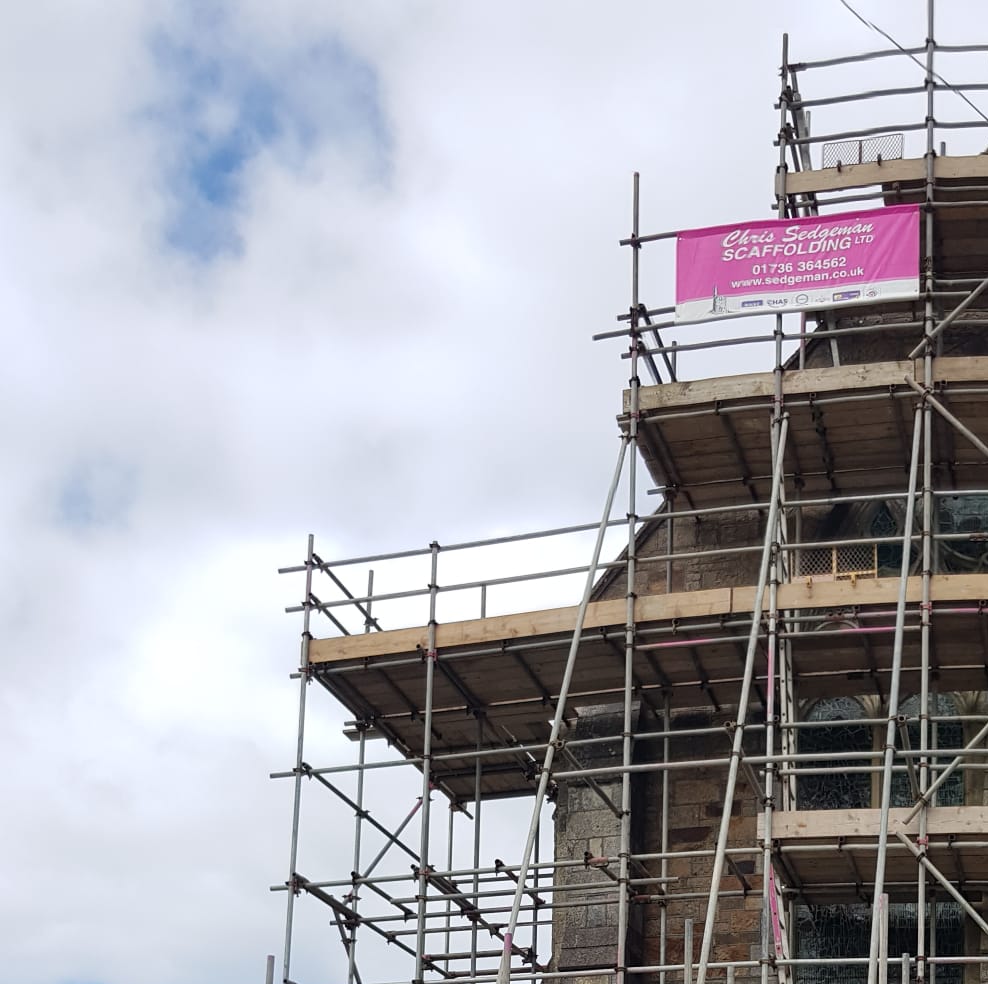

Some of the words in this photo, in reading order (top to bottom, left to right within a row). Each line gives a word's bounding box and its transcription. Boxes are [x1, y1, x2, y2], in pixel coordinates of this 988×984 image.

[722, 229, 775, 248] Chris
[782, 222, 874, 245] Sedgeman
[722, 237, 852, 261] SCAFFOLDING
[854, 234, 874, 244] LTD
[752, 262, 793, 275] 01736
[797, 256, 847, 272] 364562
[731, 267, 864, 288] www.sedgeman.co.uk
